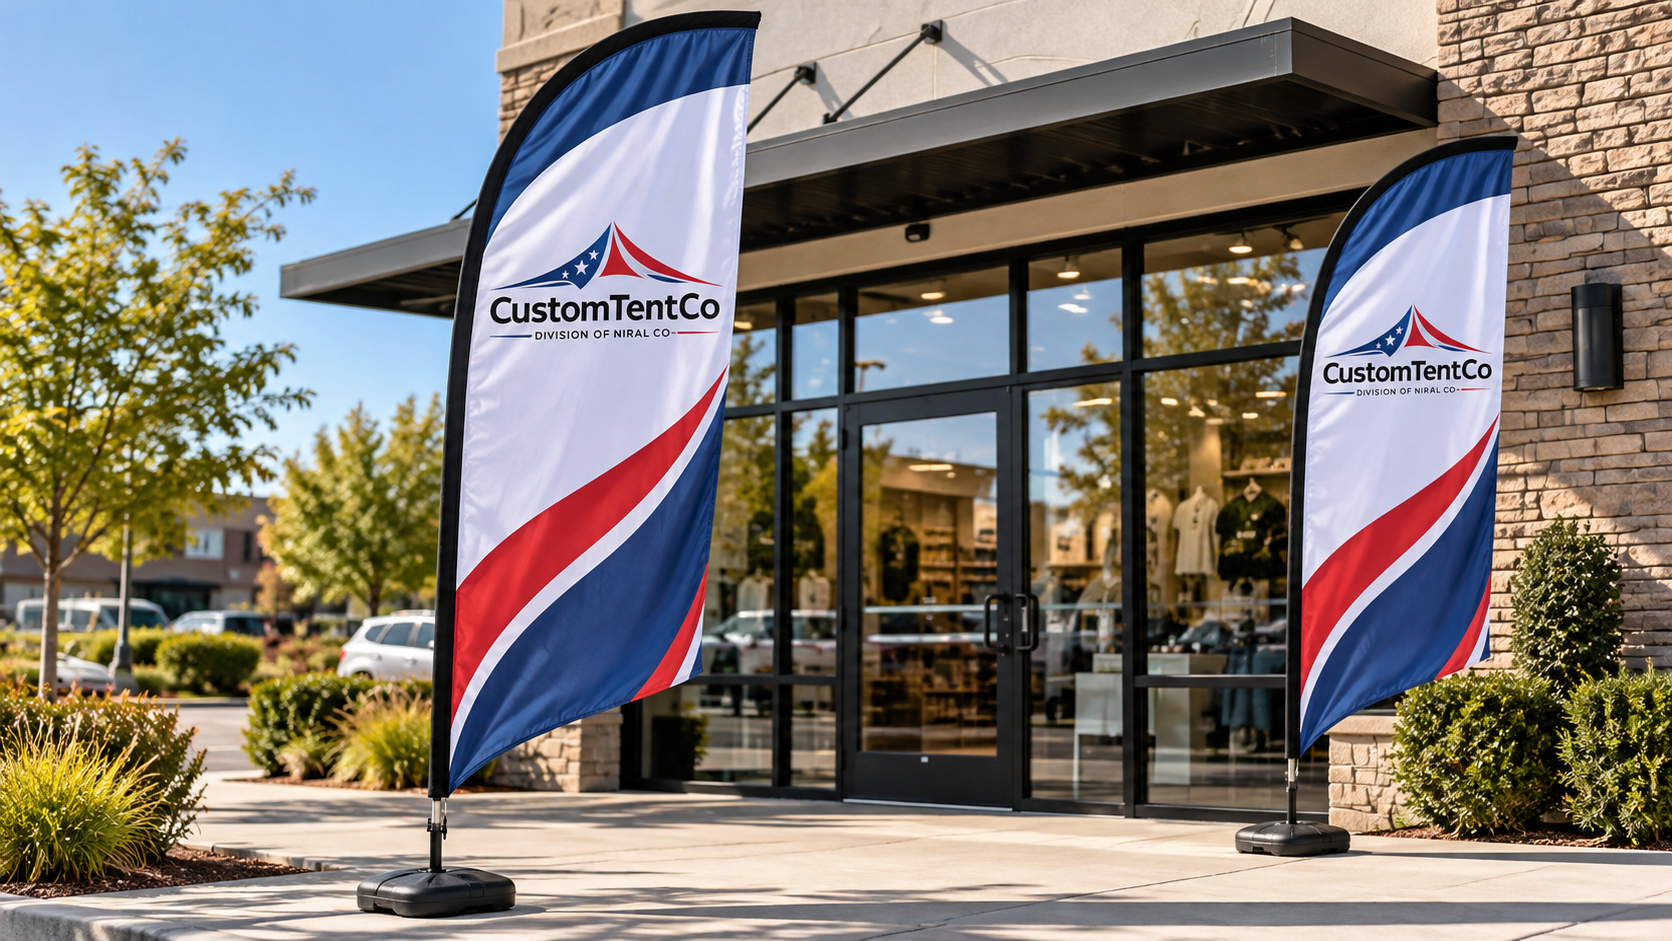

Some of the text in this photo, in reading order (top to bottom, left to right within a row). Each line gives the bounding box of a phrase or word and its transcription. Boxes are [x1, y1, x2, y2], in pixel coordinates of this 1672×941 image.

[490, 292, 720, 324] CustomTentCo
[535, 328, 671, 340] DIVISION OF NIRAL CO
[1323, 359, 1492, 384] CustomTentCo
[1356, 388, 1396, 396] DIVISION
[1399, 387, 1412, 395] OF
[1443, 386, 1456, 394] CO
